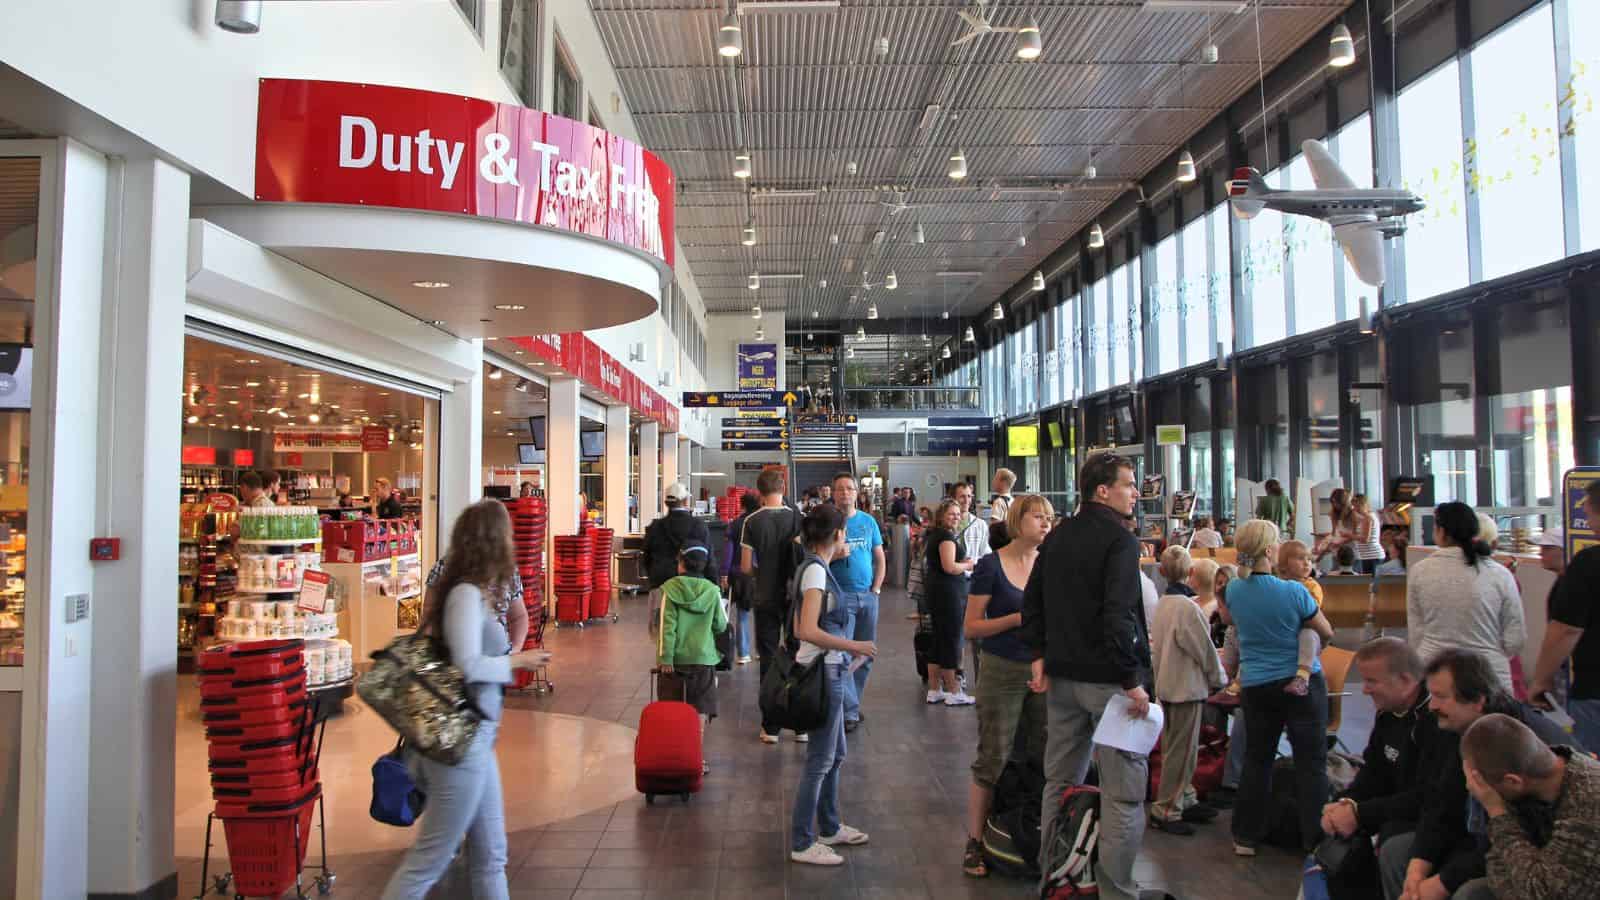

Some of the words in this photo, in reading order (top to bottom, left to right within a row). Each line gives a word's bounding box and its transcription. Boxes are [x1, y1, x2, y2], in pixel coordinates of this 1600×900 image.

[338, 115, 465, 189] Duty
[479, 132, 520, 186] &
[531, 141, 600, 203] Tax
